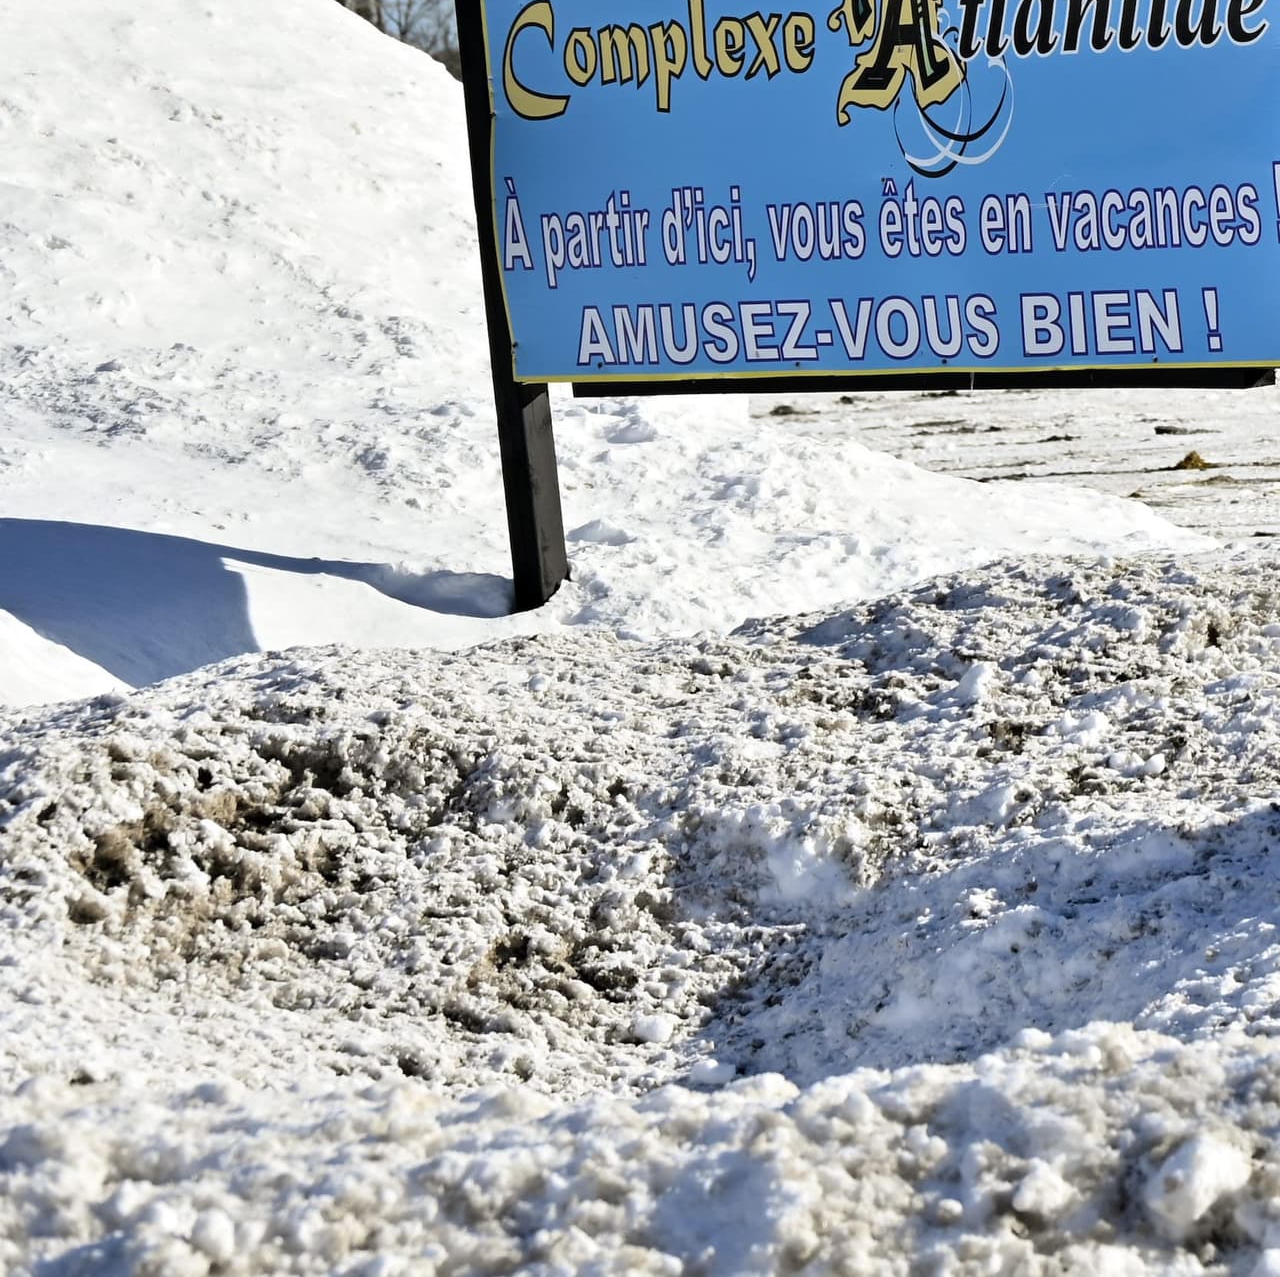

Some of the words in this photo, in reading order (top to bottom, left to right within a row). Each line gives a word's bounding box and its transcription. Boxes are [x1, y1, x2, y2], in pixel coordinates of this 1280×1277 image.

[504, 176, 534, 271] À
[541, 189, 650, 289] partir
[767, 201, 866, 261] vous
[879, 177, 967, 258] êtes
[979, 193, 1034, 254] en
[1044, 183, 1262, 251] vacances
[576, 293, 1001, 366] AMUSEZ-VOUS
[1019, 288, 1184, 358] BIEN
